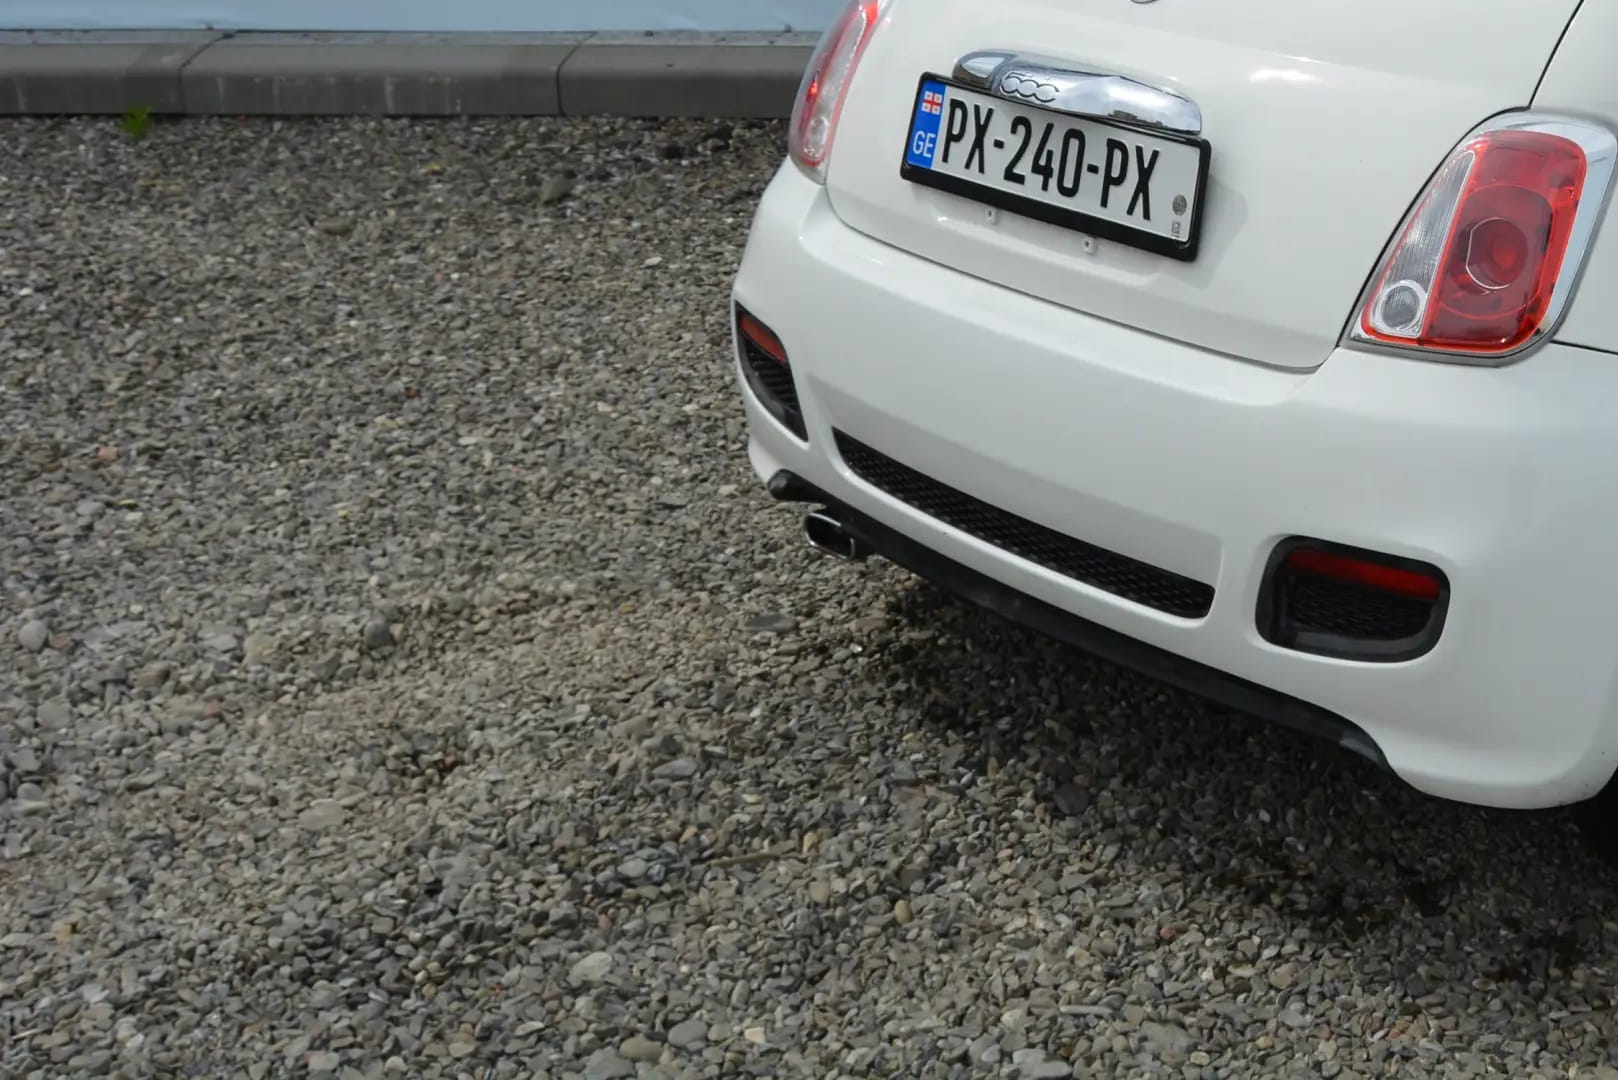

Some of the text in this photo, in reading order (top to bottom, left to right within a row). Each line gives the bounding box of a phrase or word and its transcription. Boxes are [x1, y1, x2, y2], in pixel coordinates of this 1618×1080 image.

[999, 70, 1060, 103] 500
[912, 130, 936, 159] GE
[941, 98, 1160, 221] PX-240-PX
